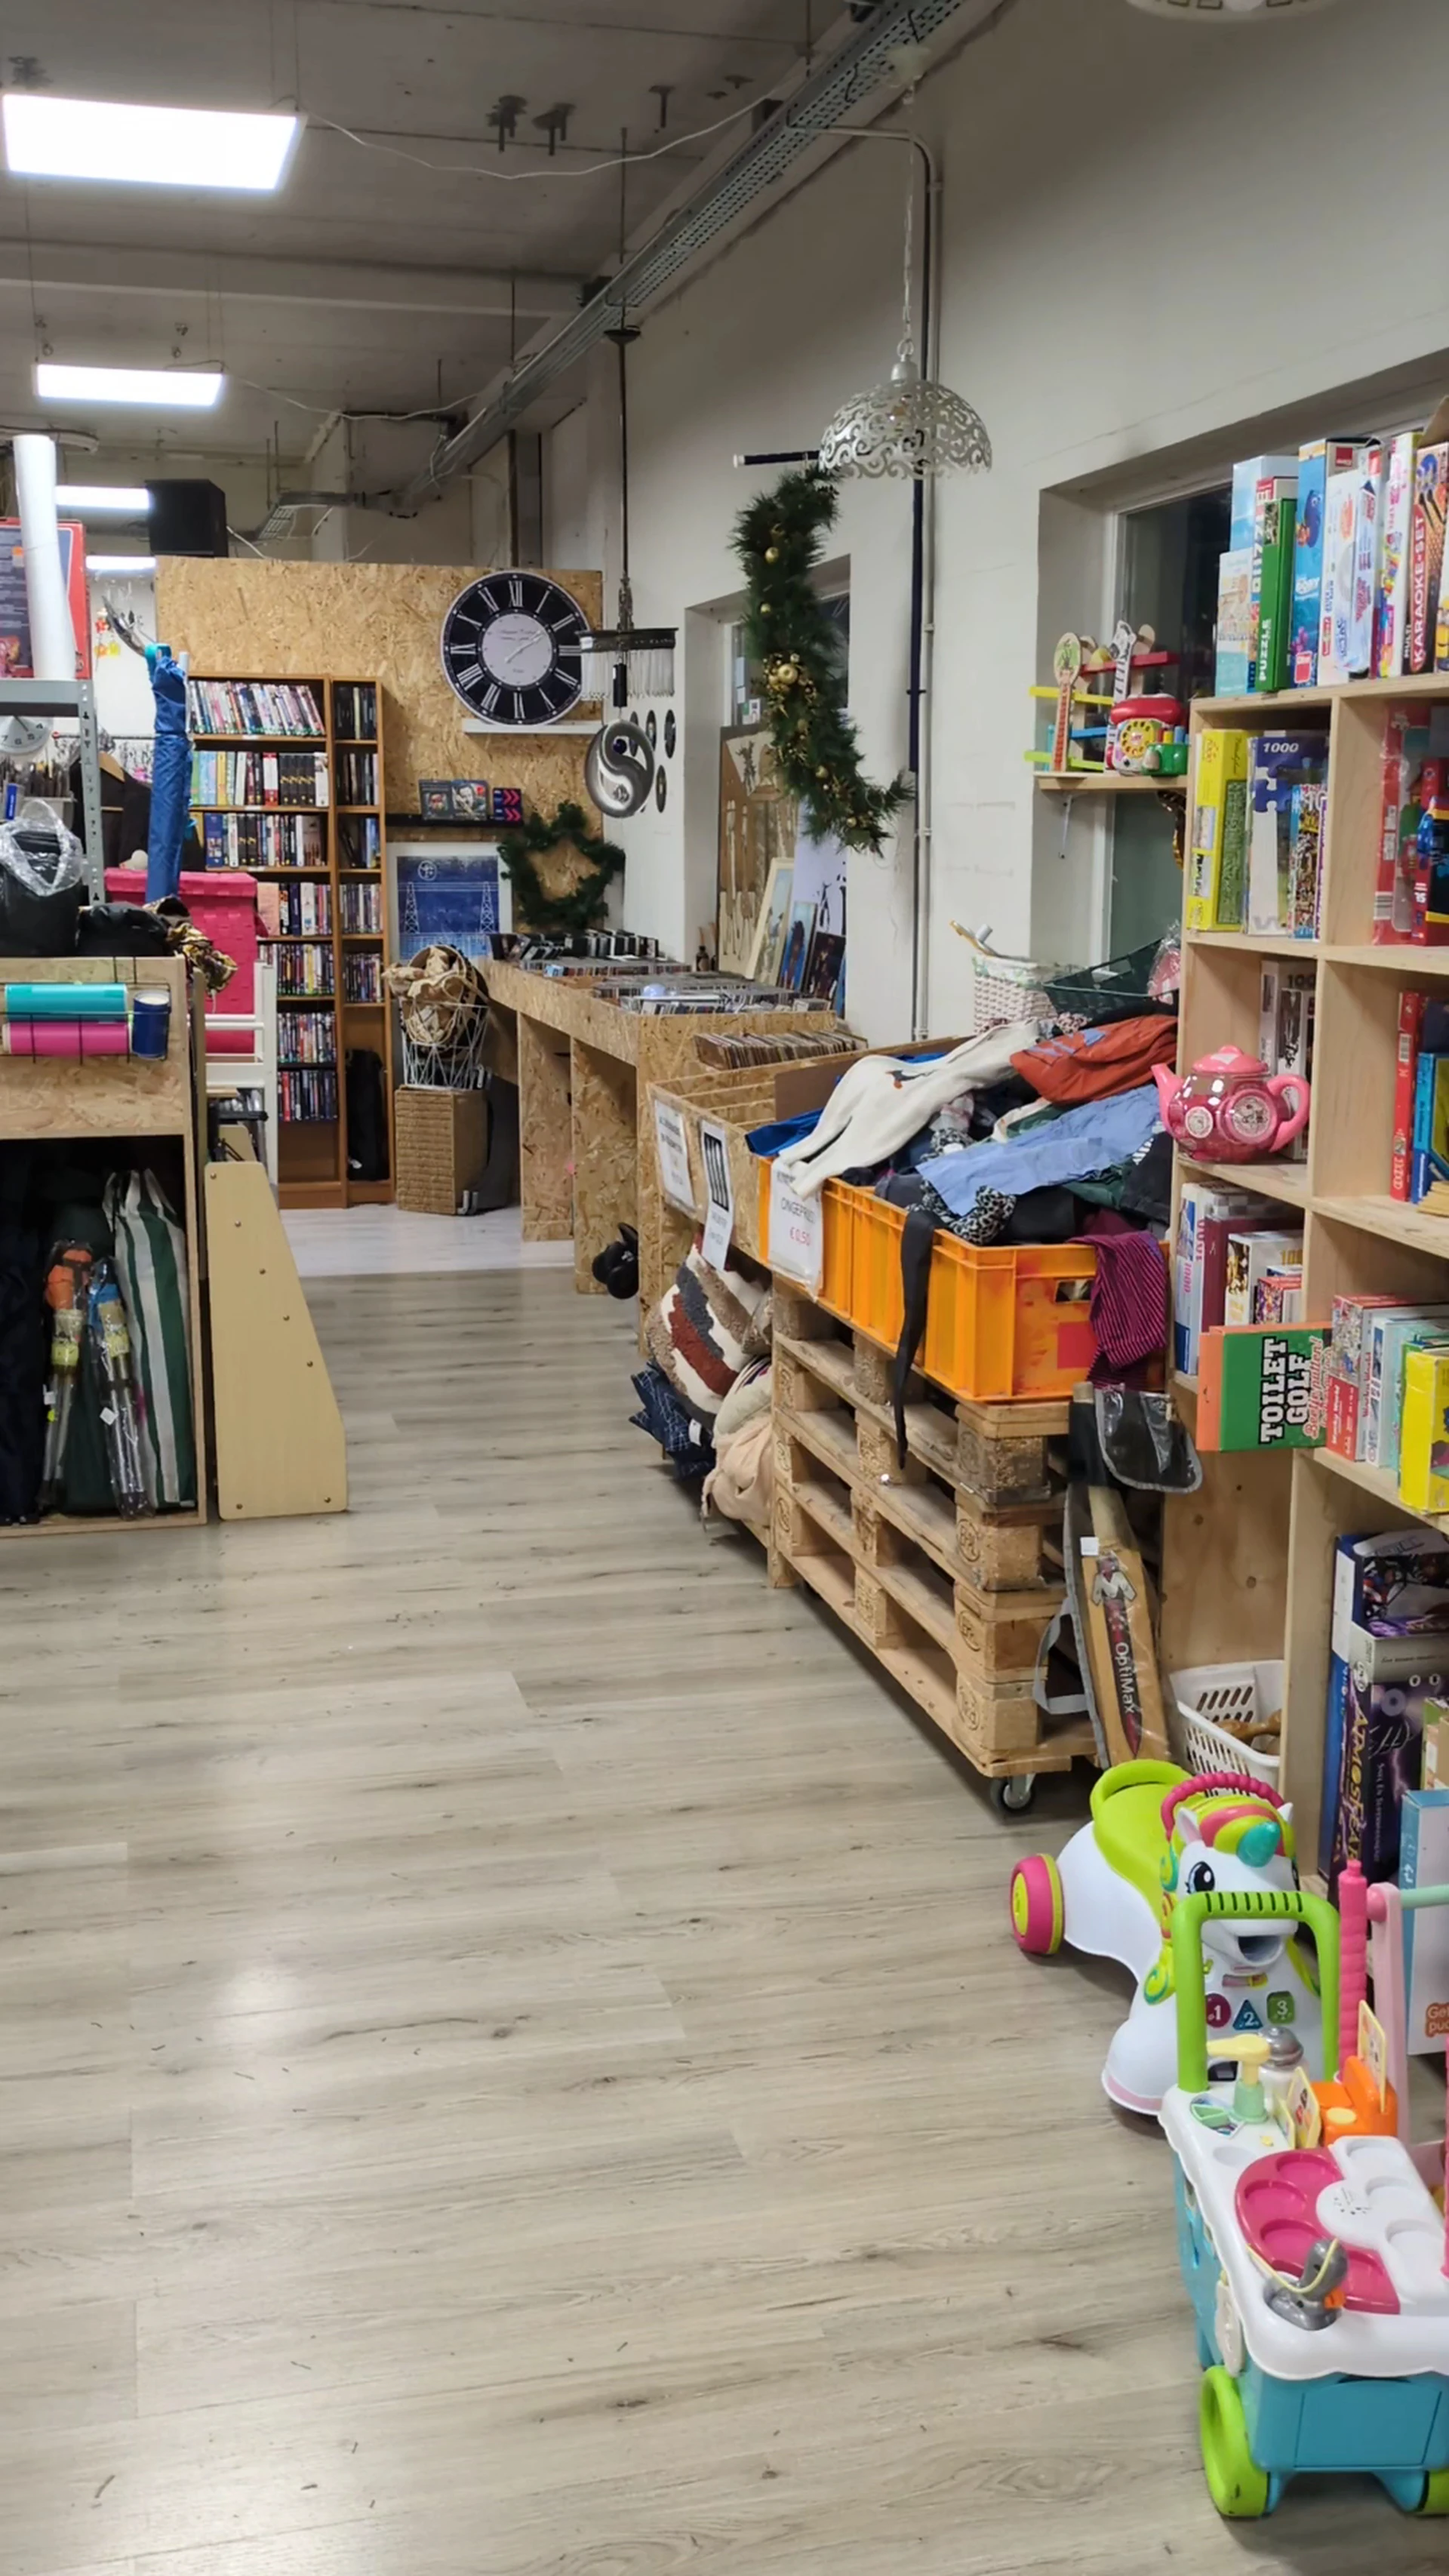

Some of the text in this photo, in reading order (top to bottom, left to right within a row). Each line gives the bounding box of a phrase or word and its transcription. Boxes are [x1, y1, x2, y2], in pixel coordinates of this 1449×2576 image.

[1413, 516, 1426, 663] KARAOKE-SET
[1259, 619, 1269, 682] PUZZLE
[1263, 743, 1299, 753] 1000
[1183, 1262, 1192, 1294] 1000
[1260, 1339, 1286, 1442] TOILET
[1285, 1354, 1311, 1424] GOLF
[1302, 1336, 1322, 1439] Beetje putten!
[1115, 1642, 1136, 1713] OptiMax
[1214, 2005, 1221, 2020] 1
[1244, 2011, 1256, 2027] 2
[1277, 2000, 1288, 2015] 3
